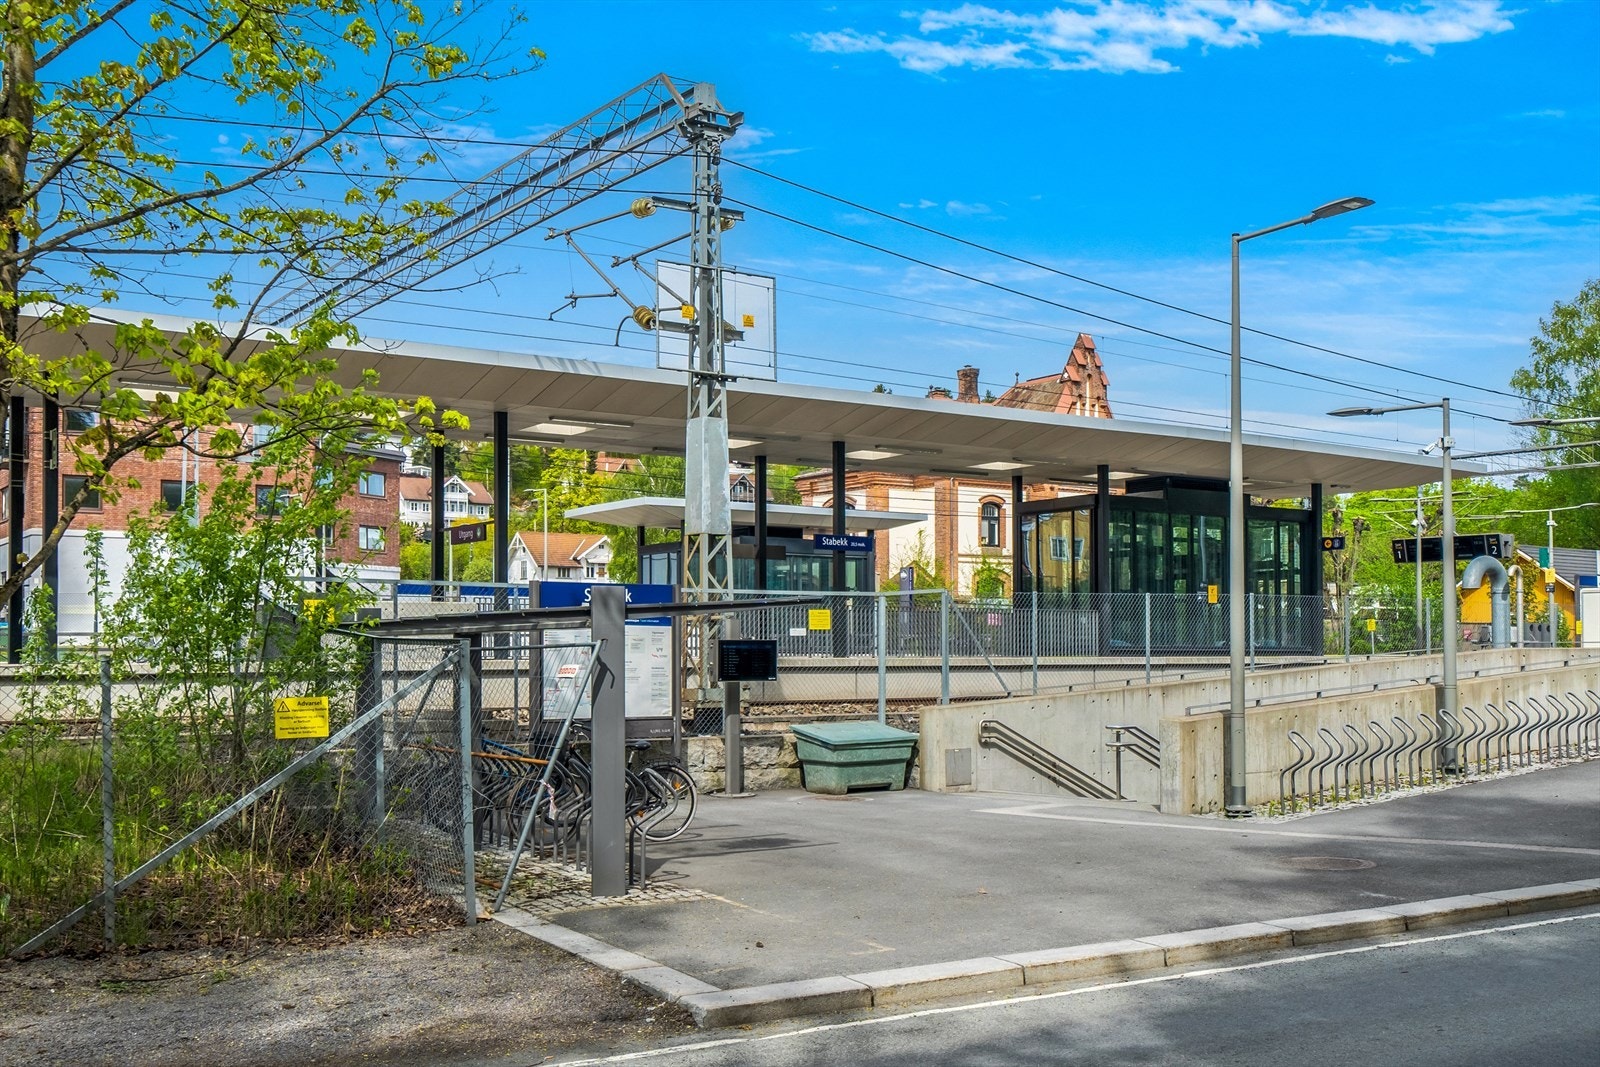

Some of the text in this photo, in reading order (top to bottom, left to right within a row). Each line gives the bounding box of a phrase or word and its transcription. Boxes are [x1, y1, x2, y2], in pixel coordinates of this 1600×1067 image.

[458, 530, 474, 540] Utgang
[822, 537, 848, 546] Stabekk
[1397, 550, 1402, 559] 1
[1491, 545, 1498, 555] 2
